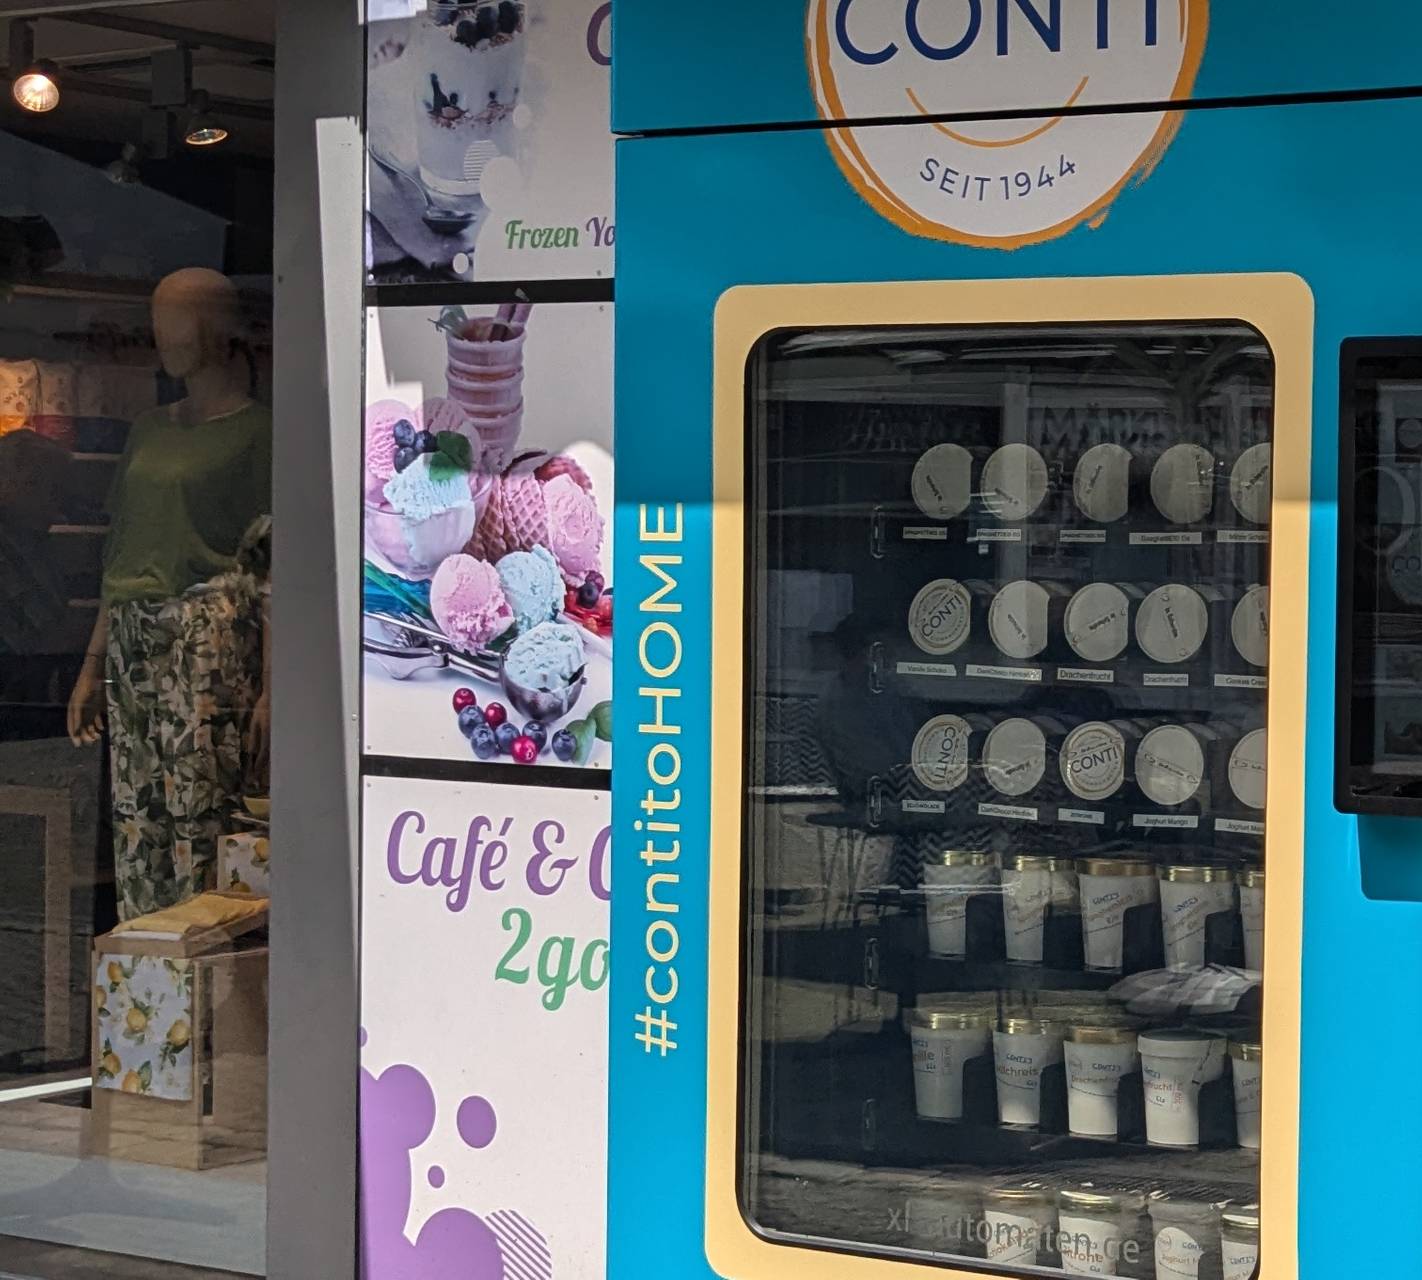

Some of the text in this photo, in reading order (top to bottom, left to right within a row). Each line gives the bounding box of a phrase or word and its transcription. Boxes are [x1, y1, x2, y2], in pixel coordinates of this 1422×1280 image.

[919, 154, 1076, 201] SEIT 1944
[505, 219, 579, 249] Frozen
[920, 594, 963, 637] CONTI
[934, 726, 956, 779] CONTI
[1071, 746, 1118, 773] CONTI
[633, 502, 684, 1058] #contitoHOME
[387, 810, 514, 912] Café
[525, 820, 579, 896] &
[495, 907, 611, 1011] 2go
